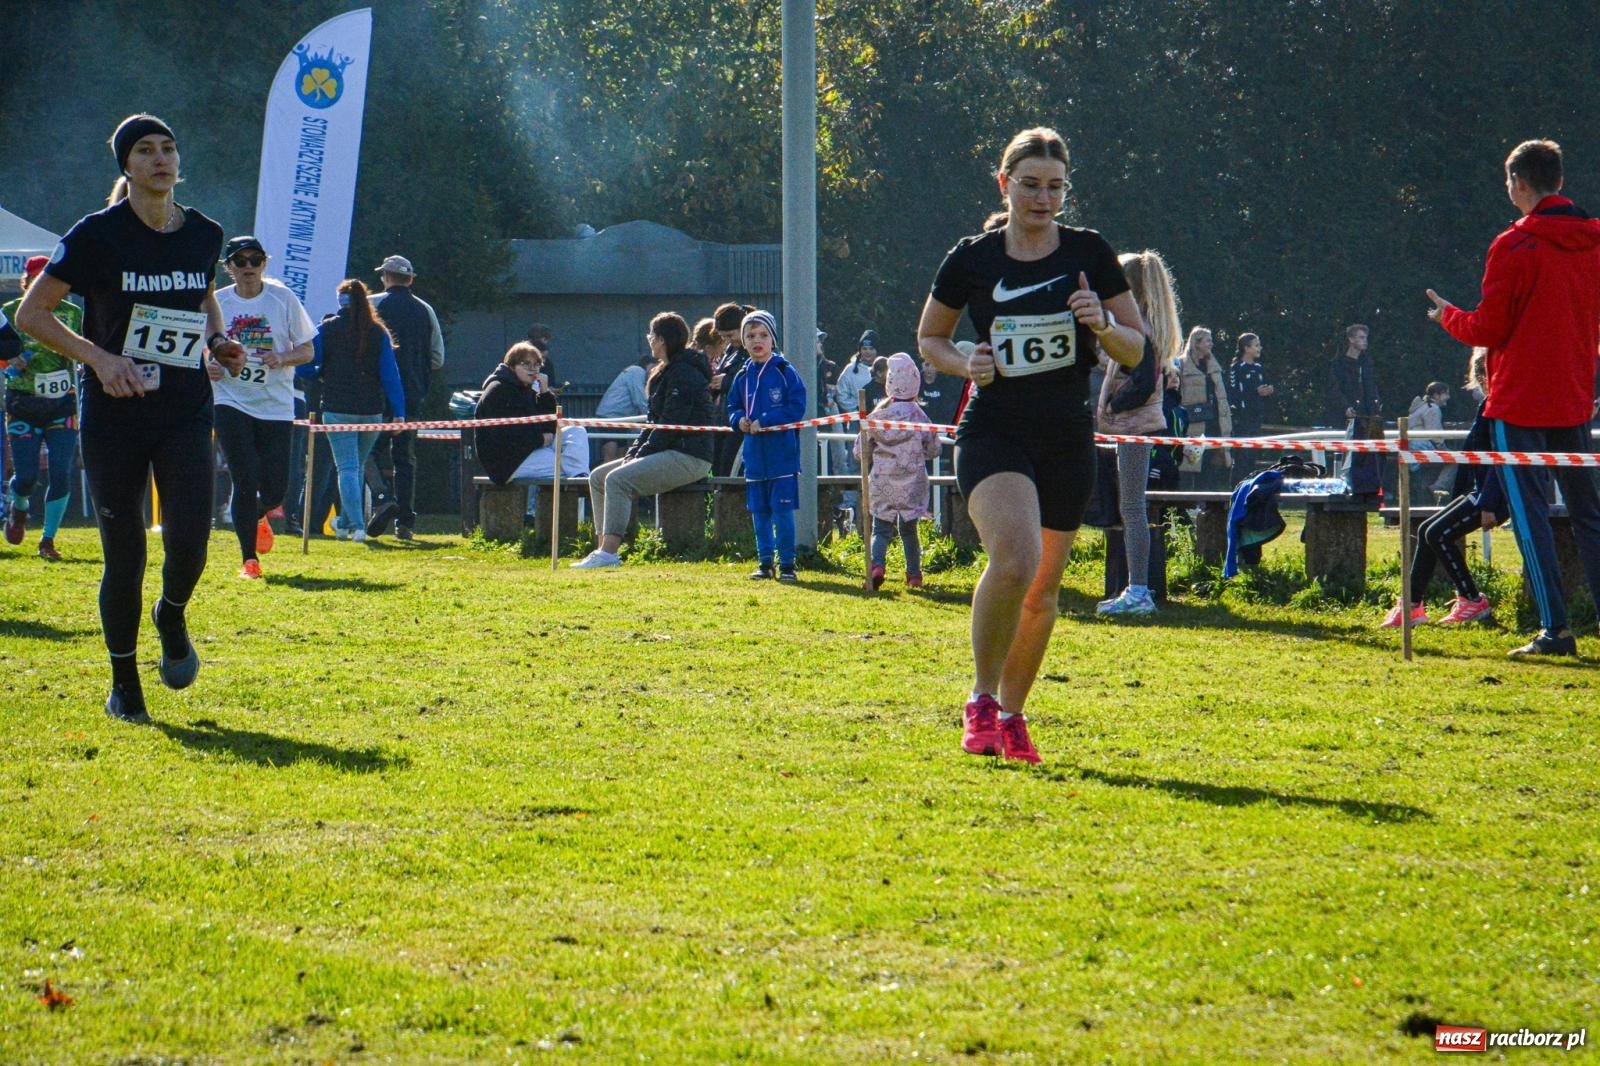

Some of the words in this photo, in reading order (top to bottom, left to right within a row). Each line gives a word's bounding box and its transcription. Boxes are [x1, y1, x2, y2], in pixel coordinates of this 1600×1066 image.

[294, 116, 328, 198] STOWARZYSZENIE
[289, 198, 317, 242] AKTYWNI
[286, 243, 312, 262] DLA
[282, 265, 309, 306] LEPSZ
[133, 325, 201, 357] 157
[998, 335, 1071, 365] 163
[37, 380, 69, 394] 180
